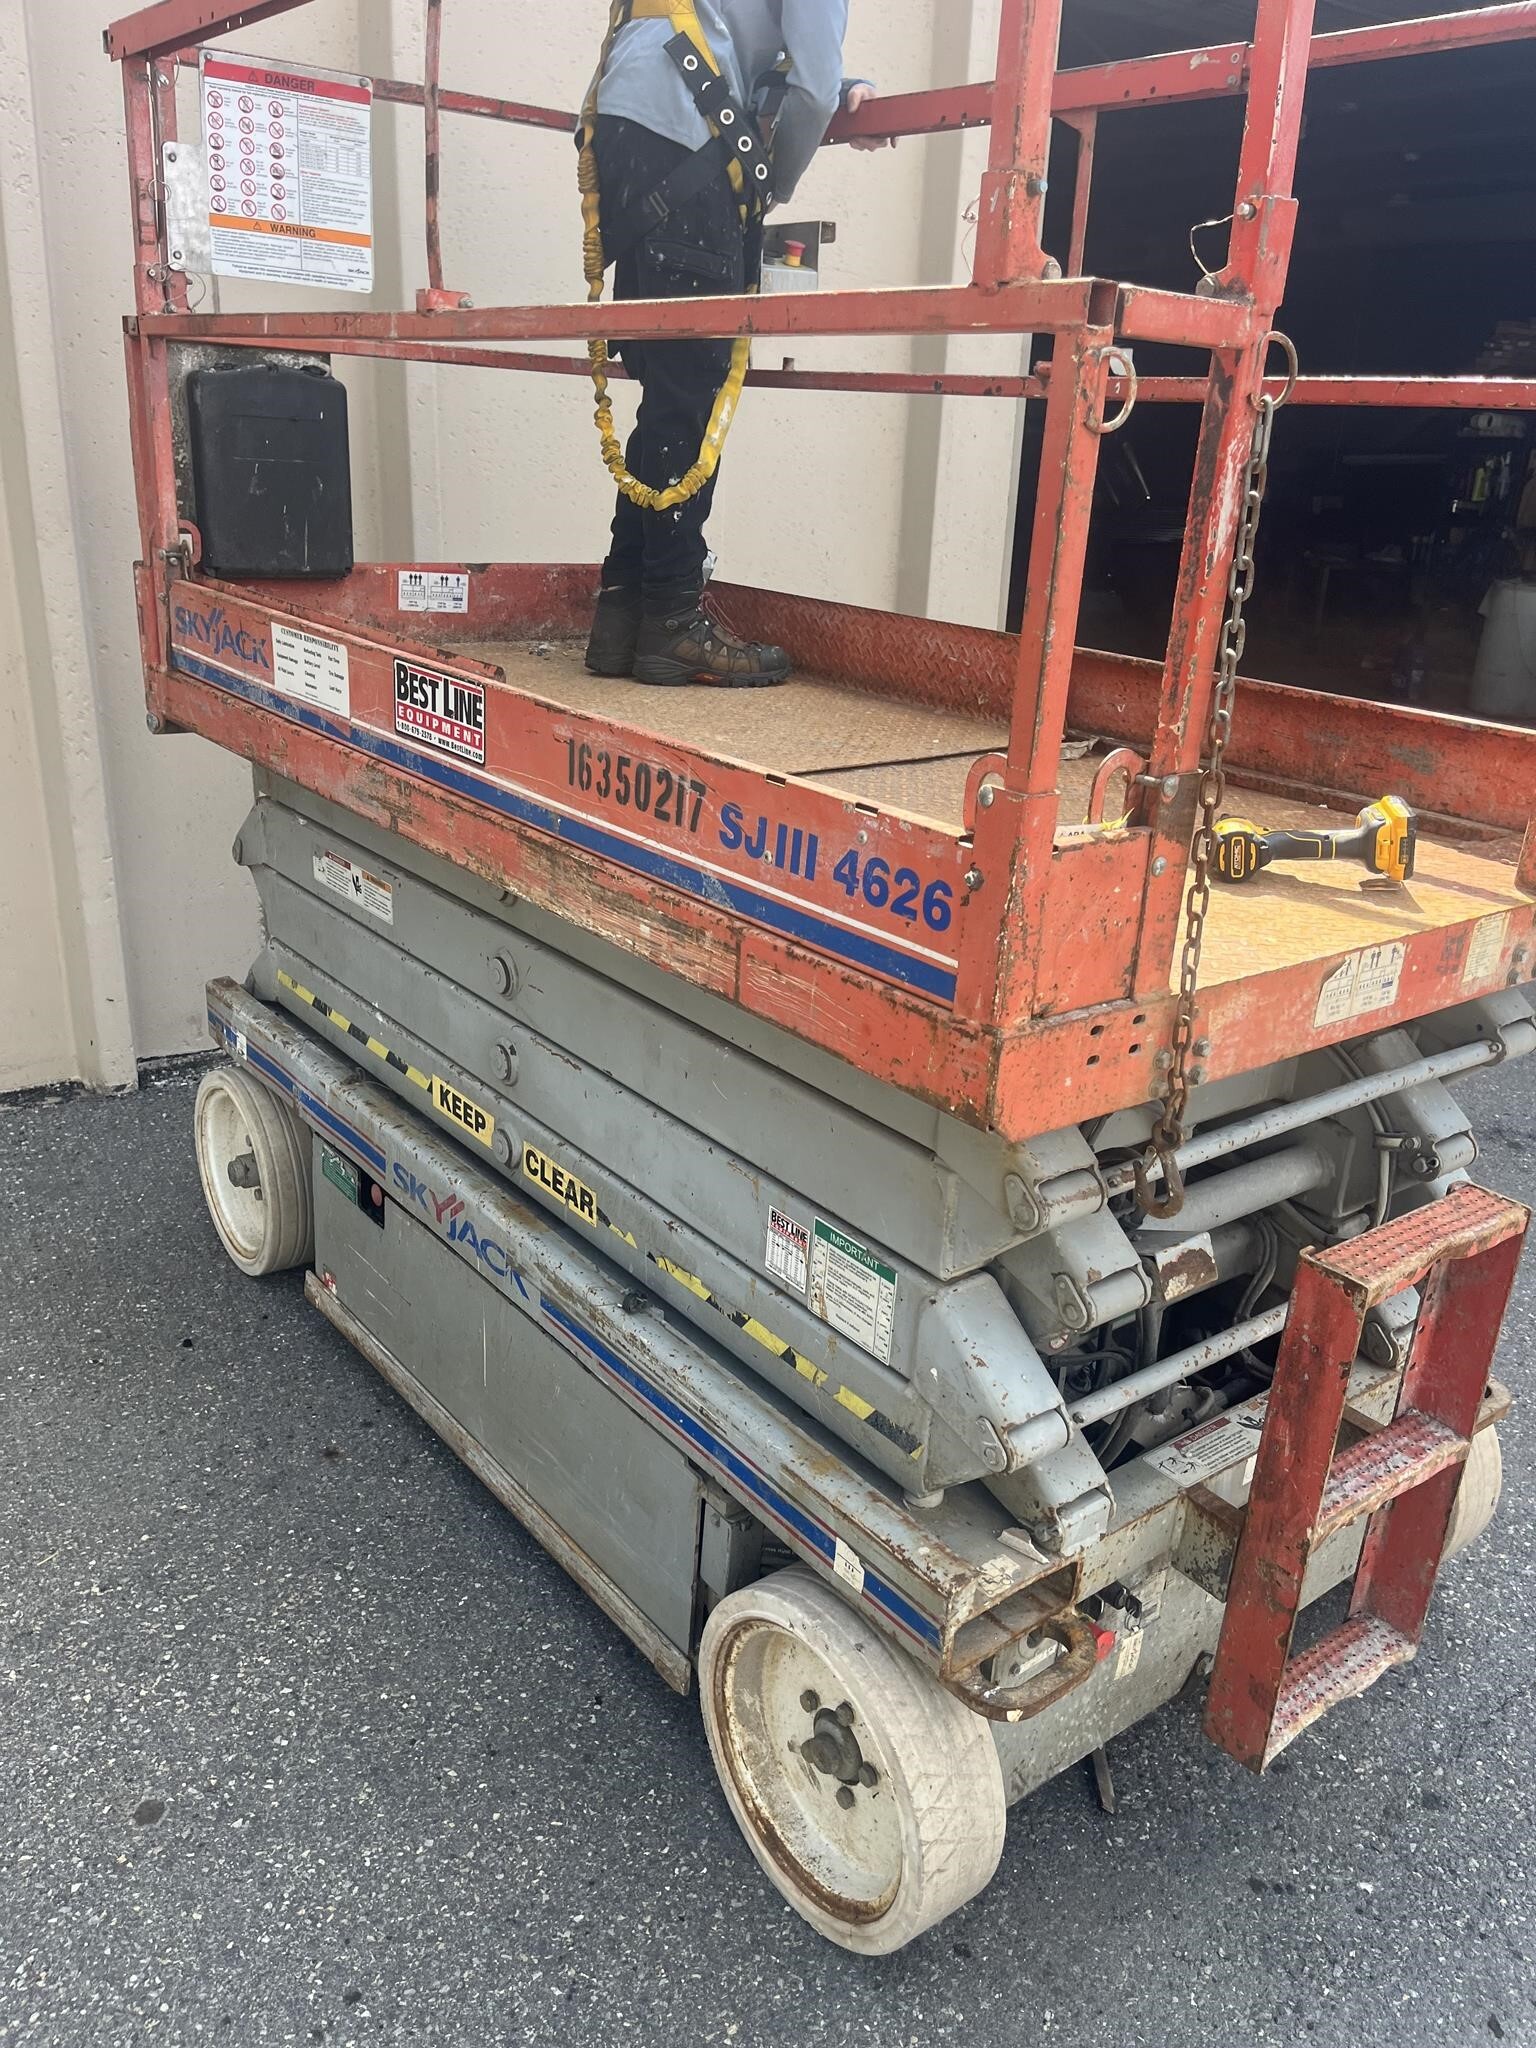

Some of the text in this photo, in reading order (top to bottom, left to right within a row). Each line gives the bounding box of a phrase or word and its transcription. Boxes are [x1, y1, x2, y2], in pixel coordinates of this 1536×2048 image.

[264, 73, 315, 92] DANGER
[270, 223, 316, 238] WARNING
[175, 606, 270, 669] SKYJACK
[396, 662, 440, 713] BEST
[443, 677, 483, 730] LINE
[398, 705, 481, 748] EQUIPMENT
[566, 738, 707, 833] 16350217
[833, 849, 953, 933] 4626
[439, 1083, 594, 1219] KEEP CLEAR
[771, 1210, 789, 1231] BEST
[791, 1223, 808, 1243] LINE
[829, 1232, 881, 1271] IMPORTANT
